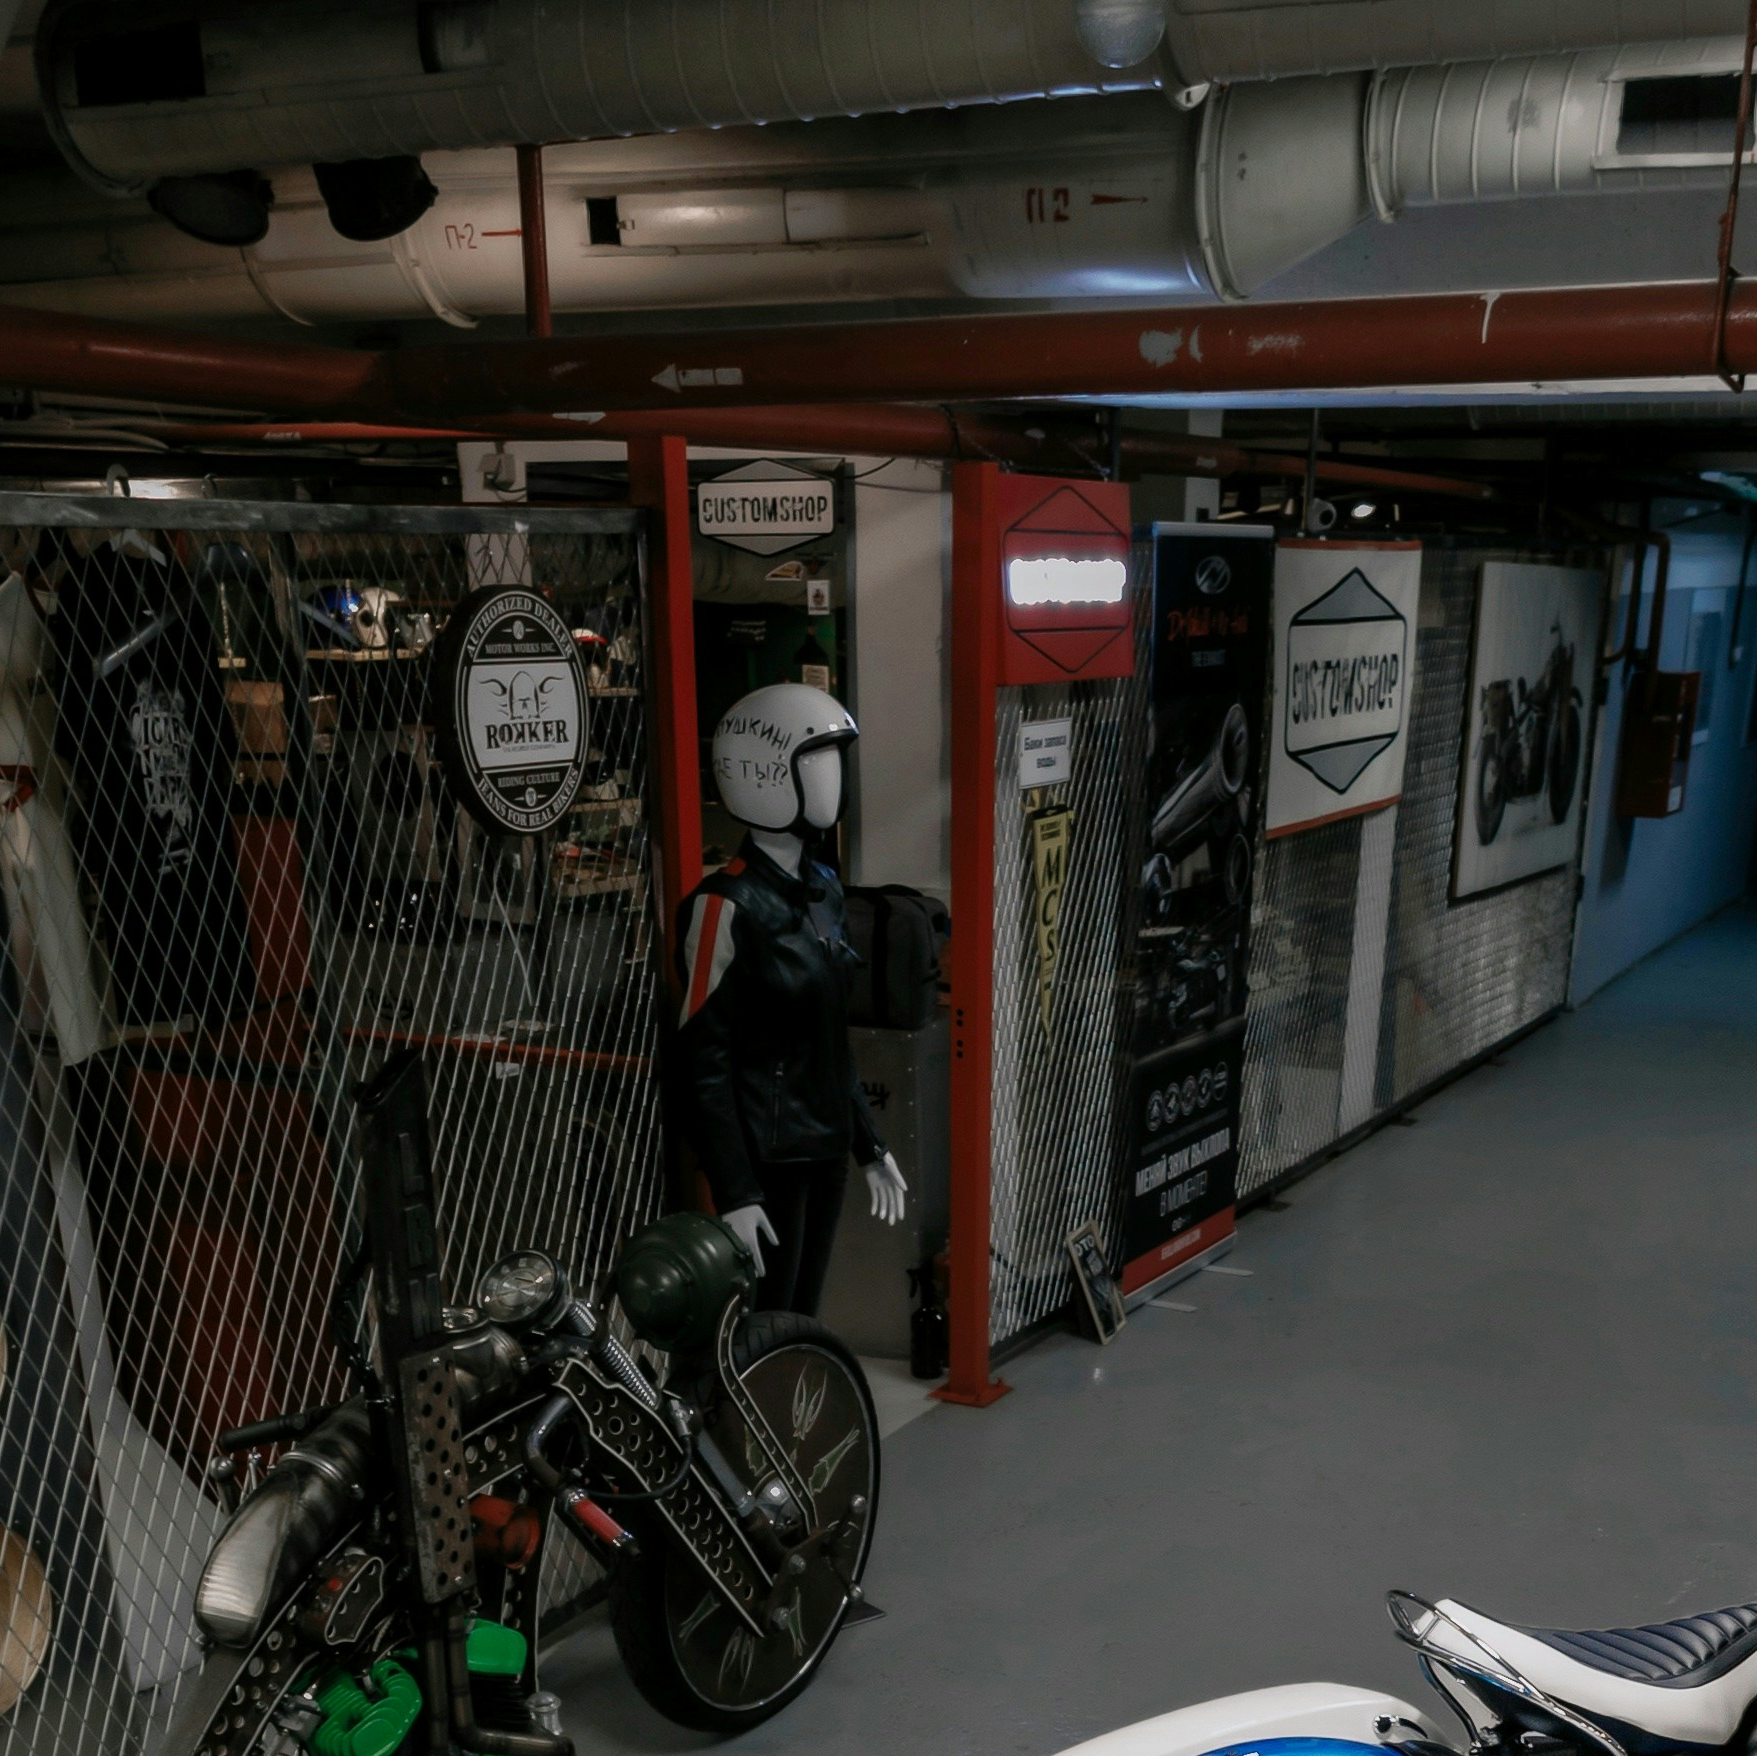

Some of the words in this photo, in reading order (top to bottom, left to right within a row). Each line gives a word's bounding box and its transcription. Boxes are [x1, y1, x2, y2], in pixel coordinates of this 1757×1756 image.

[702, 495, 828, 524] CUSTOMSHOP
[466, 596, 532, 659] AUTHORIZED
[534, 601, 573, 659] DEALER
[485, 643, 512, 655] MOTOR
[513, 642, 541, 654] WORKS
[1292, 652, 1399, 725] CUSTOMSHOP
[485, 719, 570, 750] ROKKER
[497, 775, 525, 788] RIDING
[525, 771, 561, 786] CULTURE
[477, 777, 508, 818] JEANS
[507, 808, 528, 827] FOR
[528, 805, 554, 827] REAL
